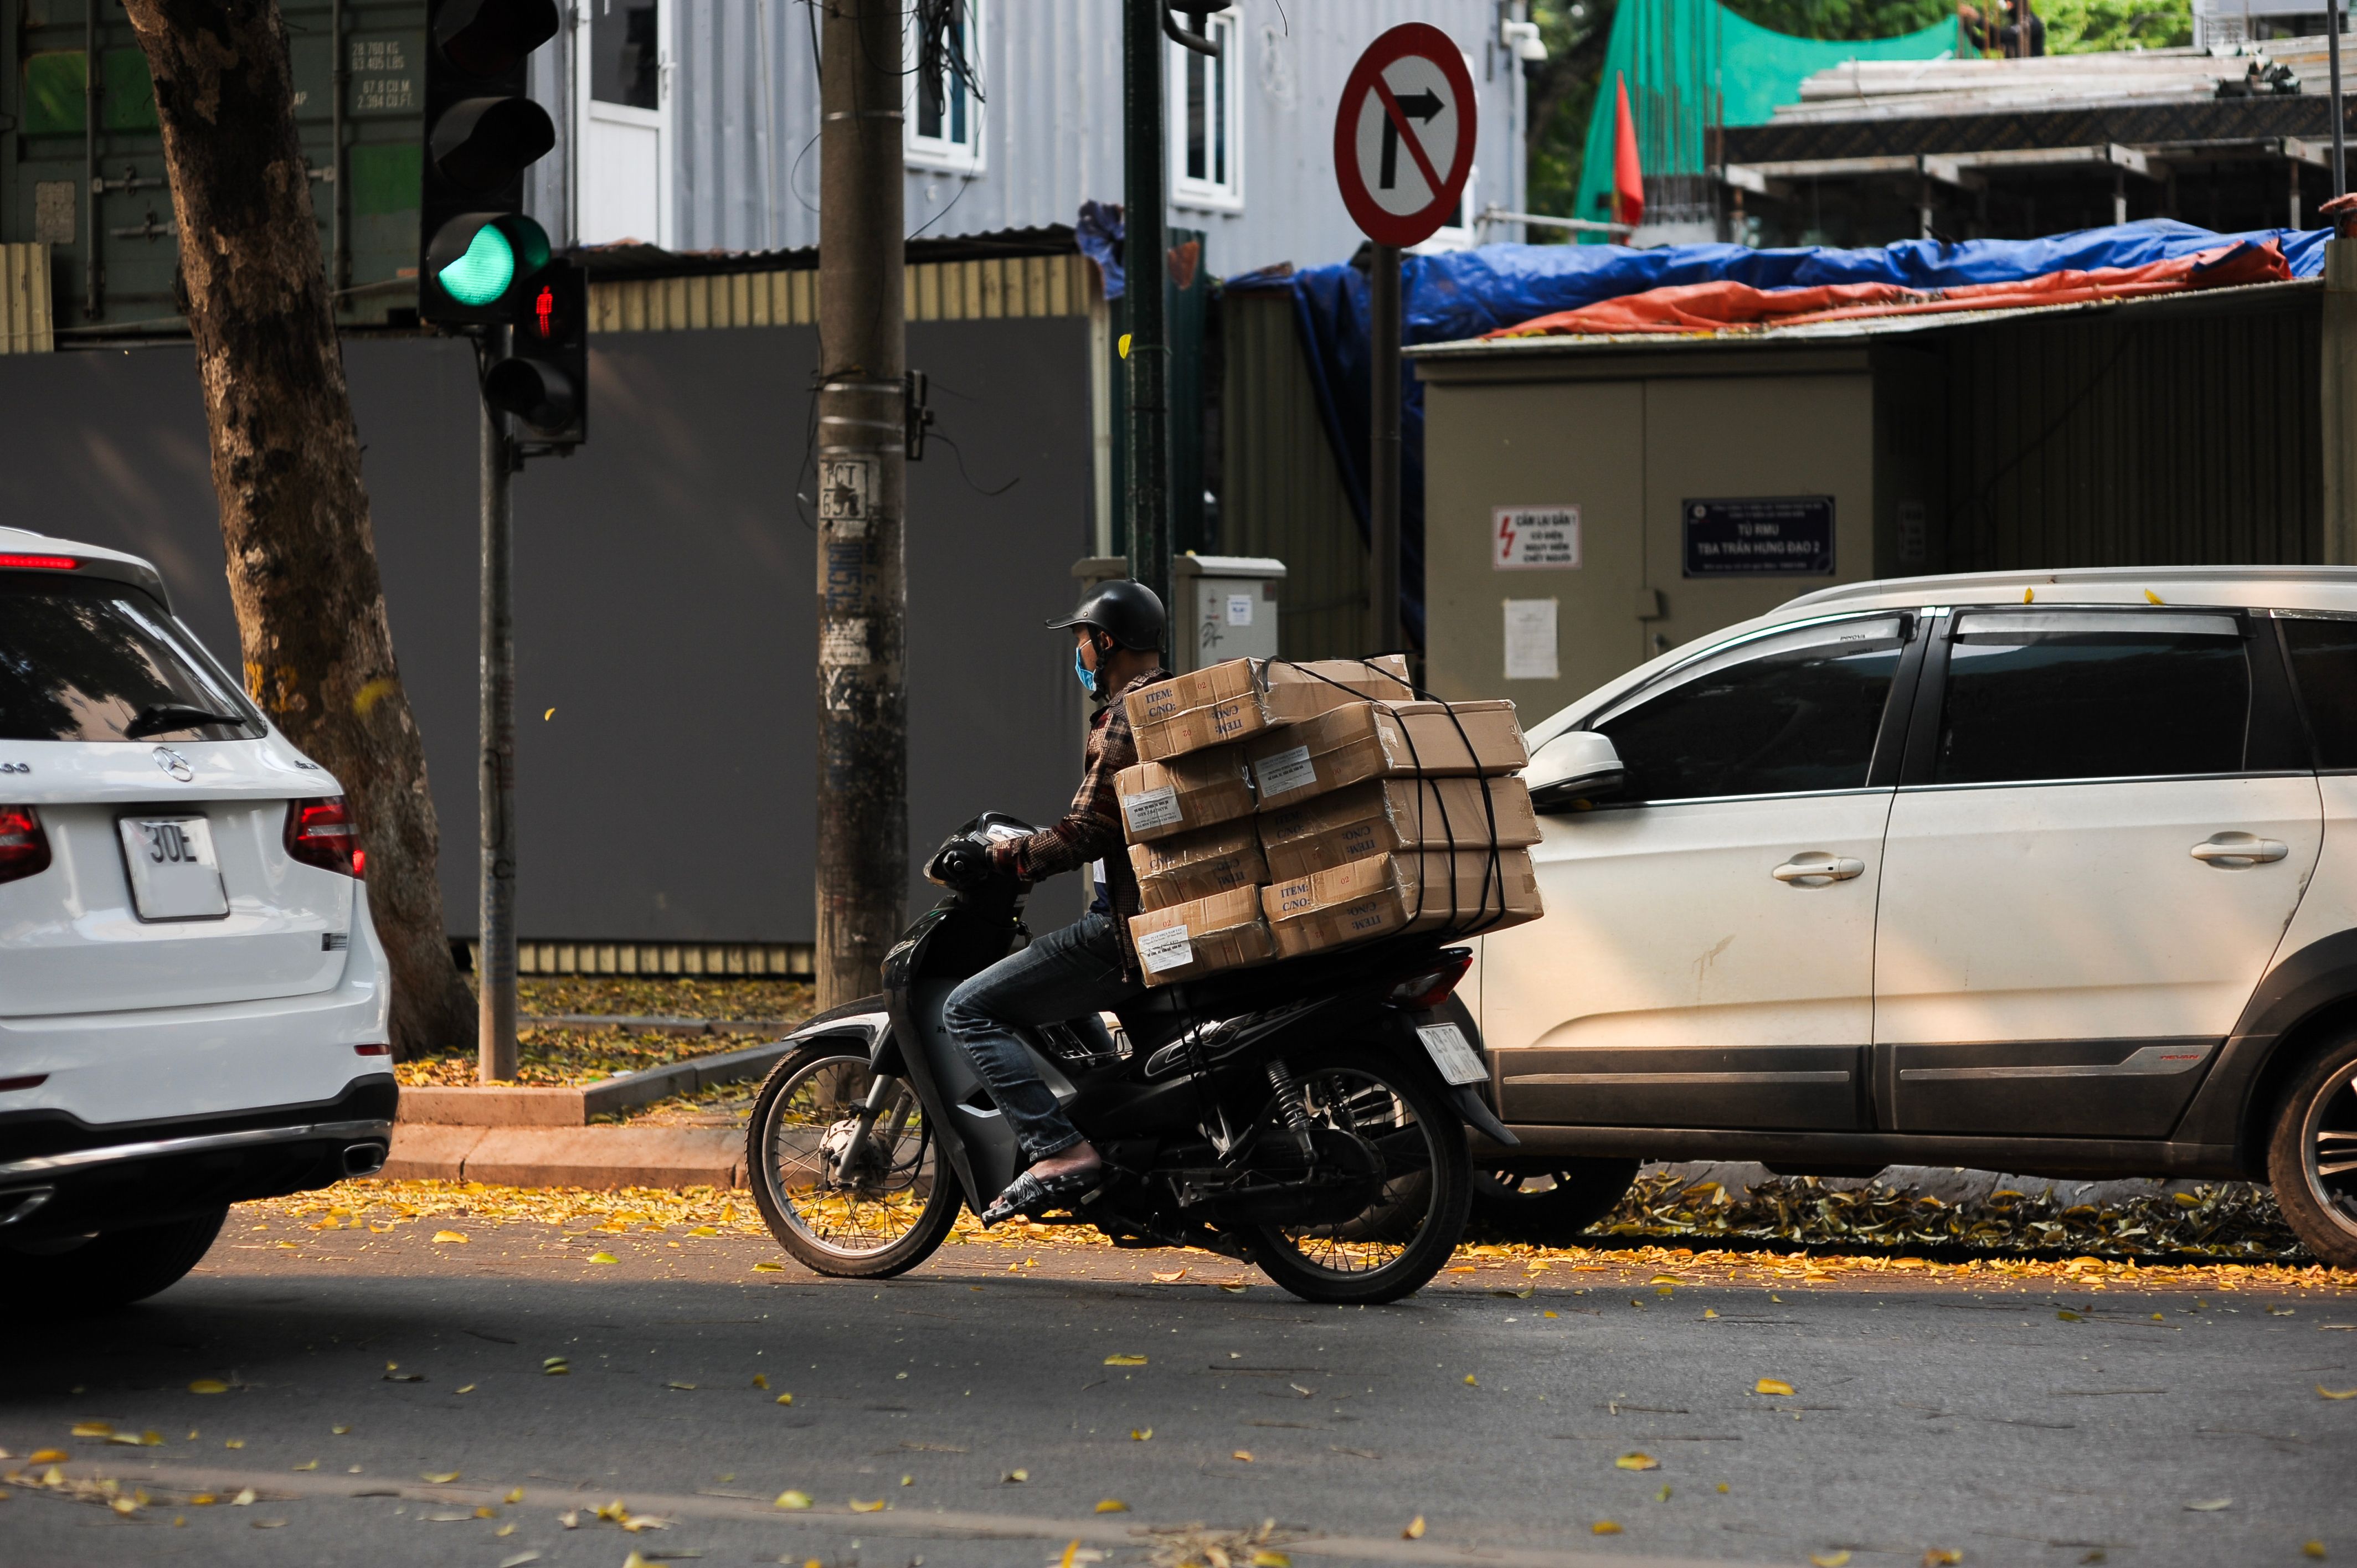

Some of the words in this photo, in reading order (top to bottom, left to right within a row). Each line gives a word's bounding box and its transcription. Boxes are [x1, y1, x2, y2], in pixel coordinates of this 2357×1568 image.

[1754, 524, 1780, 537] RMU
[1698, 542, 1719, 555] TBA
[1787, 540, 1812, 556] ĐẠO
[1146, 689, 1172, 704] ITEM:
[1149, 703, 1176, 717] C/NO:
[1212, 705, 1239, 719] C/NO:
[1216, 719, 1243, 734] ITEM:
[1277, 825, 1304, 839] C/NO:
[1342, 826, 1371, 840] C/NO:
[143, 821, 198, 864] 30E
[1347, 839, 1375, 854] ITEM:
[1341, 876, 1350, 884] 02
[1280, 884, 1309, 898] ITEM:
[1283, 898, 1310, 911] C/NO:
[1347, 901, 1376, 916] C/NO:
[1352, 915, 1381, 930] ITEM:
[1315, 930, 1324, 938] 02
